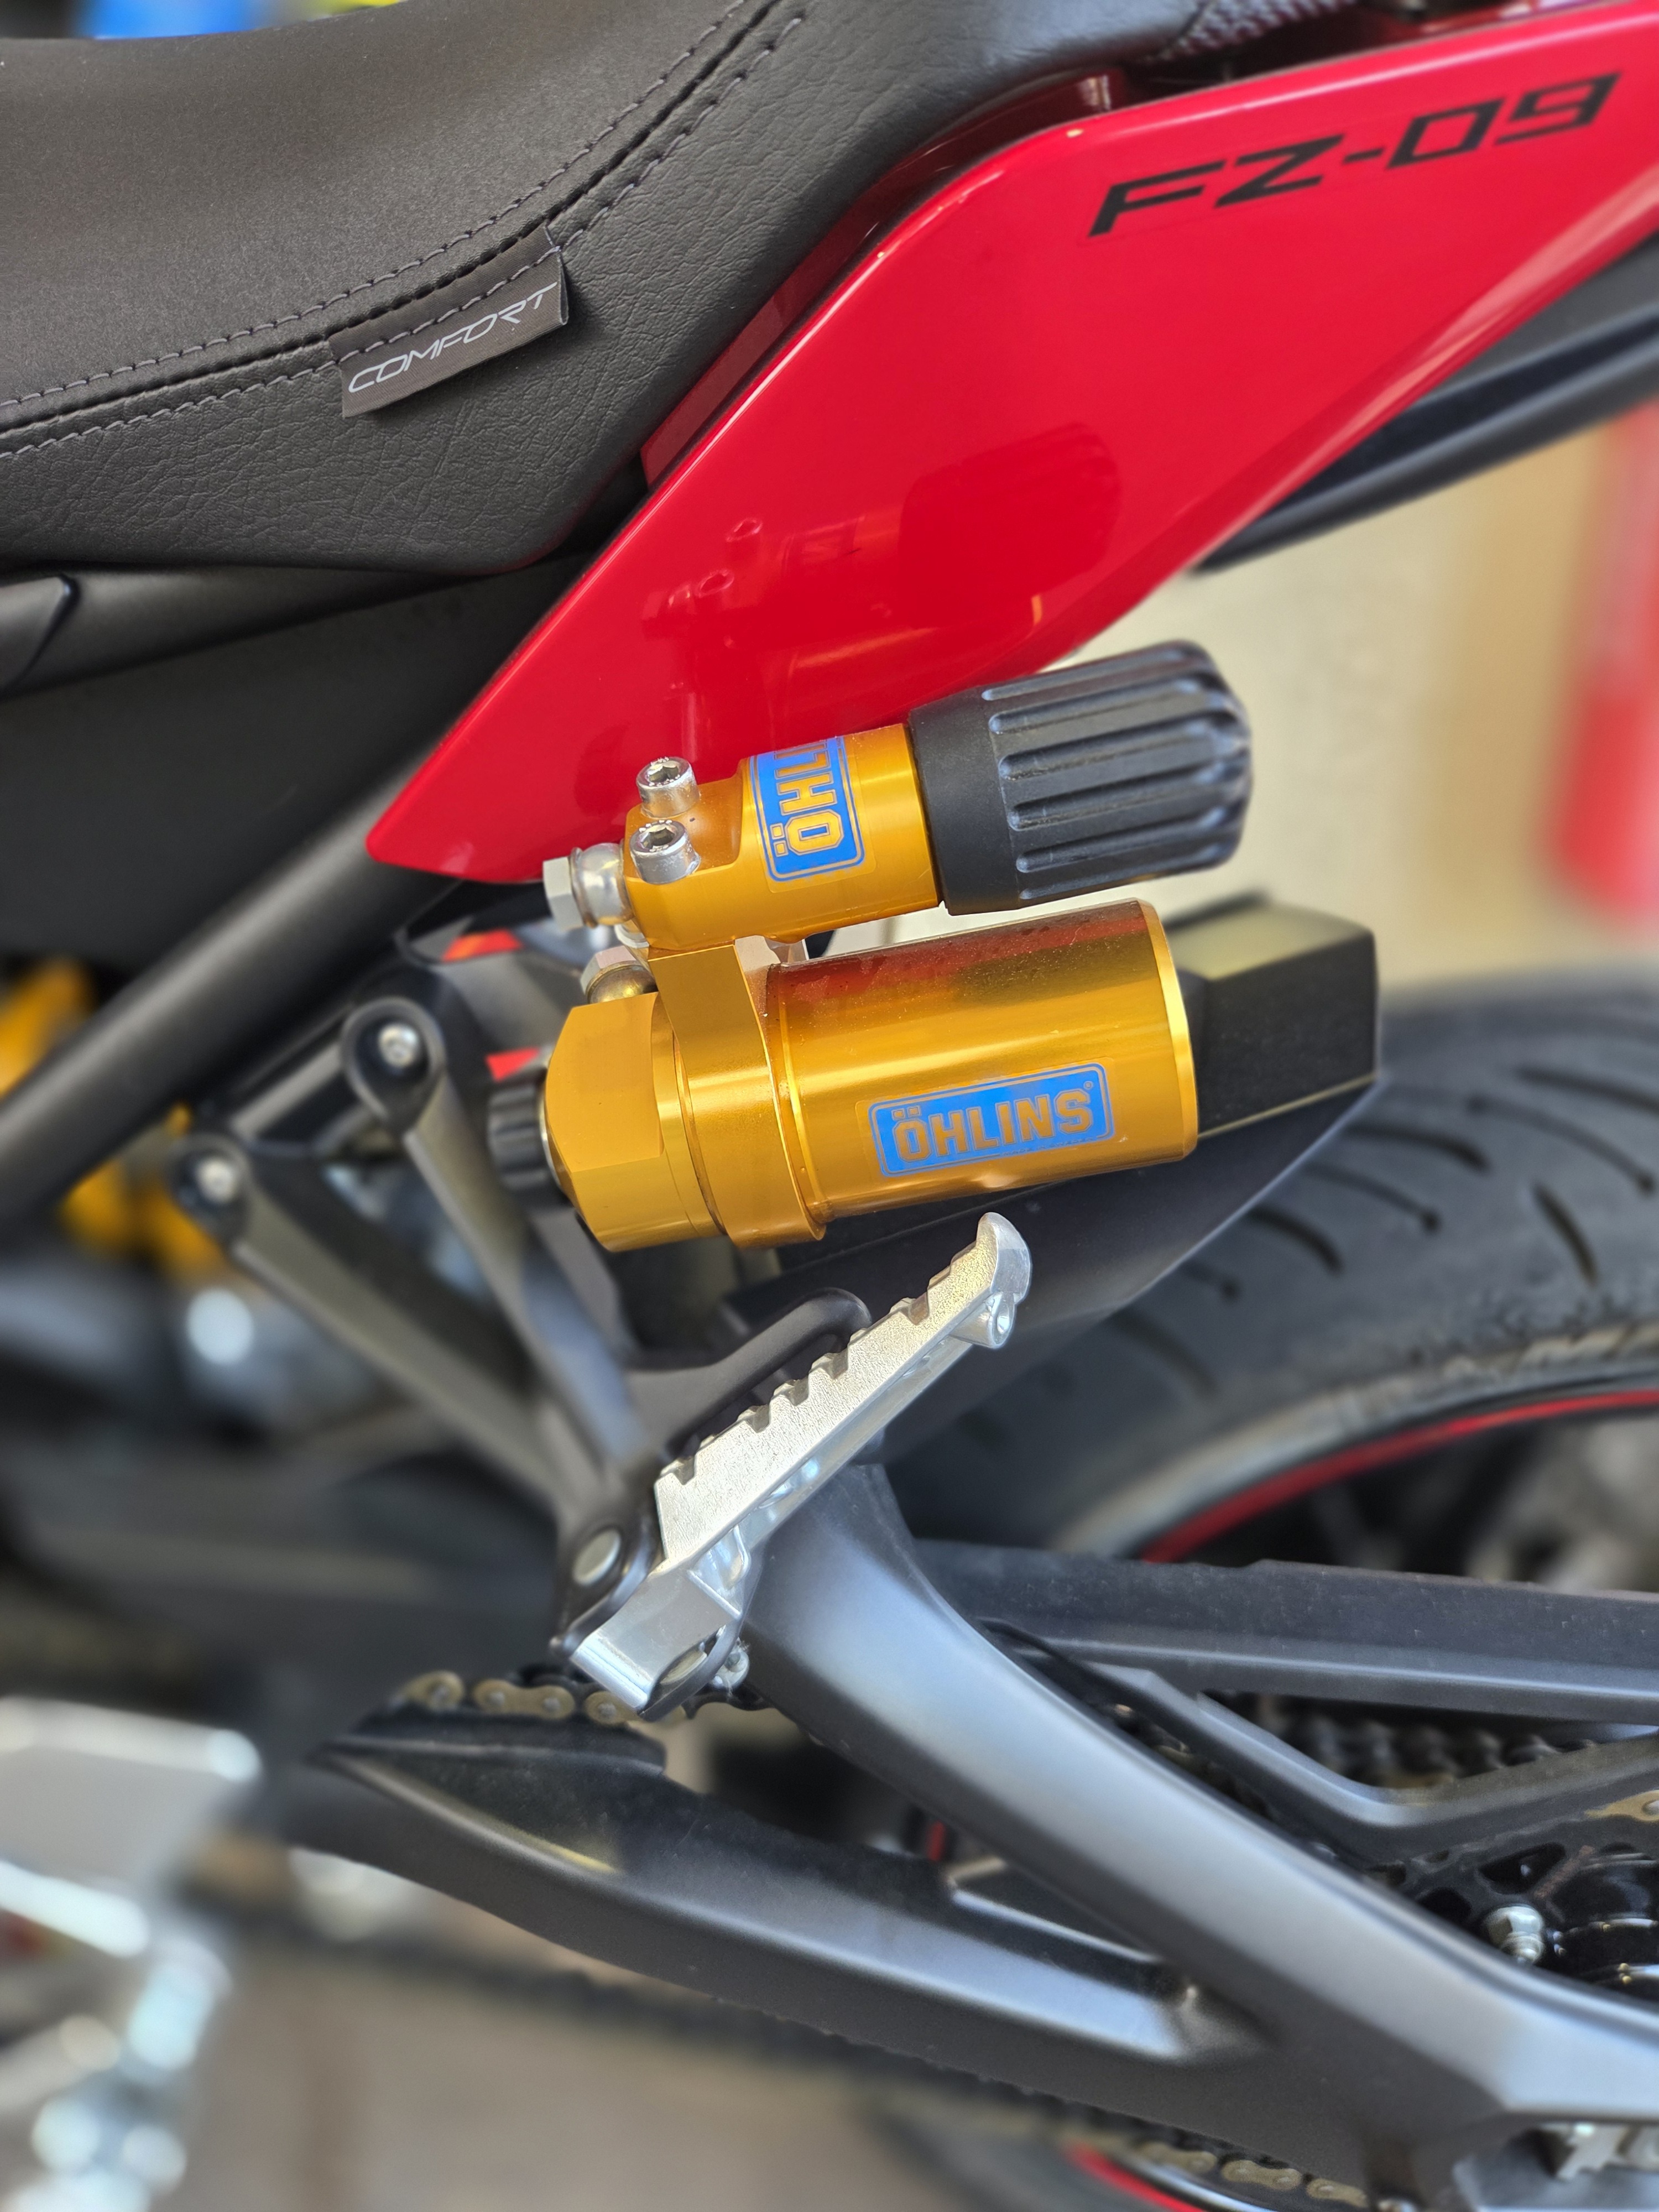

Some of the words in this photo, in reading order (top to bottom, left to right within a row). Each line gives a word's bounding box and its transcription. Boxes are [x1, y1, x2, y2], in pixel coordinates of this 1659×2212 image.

[1089, 72, 1620, 237] FZ-09
[348, 281, 557, 393] COMFORT
[892, 1088, 1093, 1162] ÖHLINS
